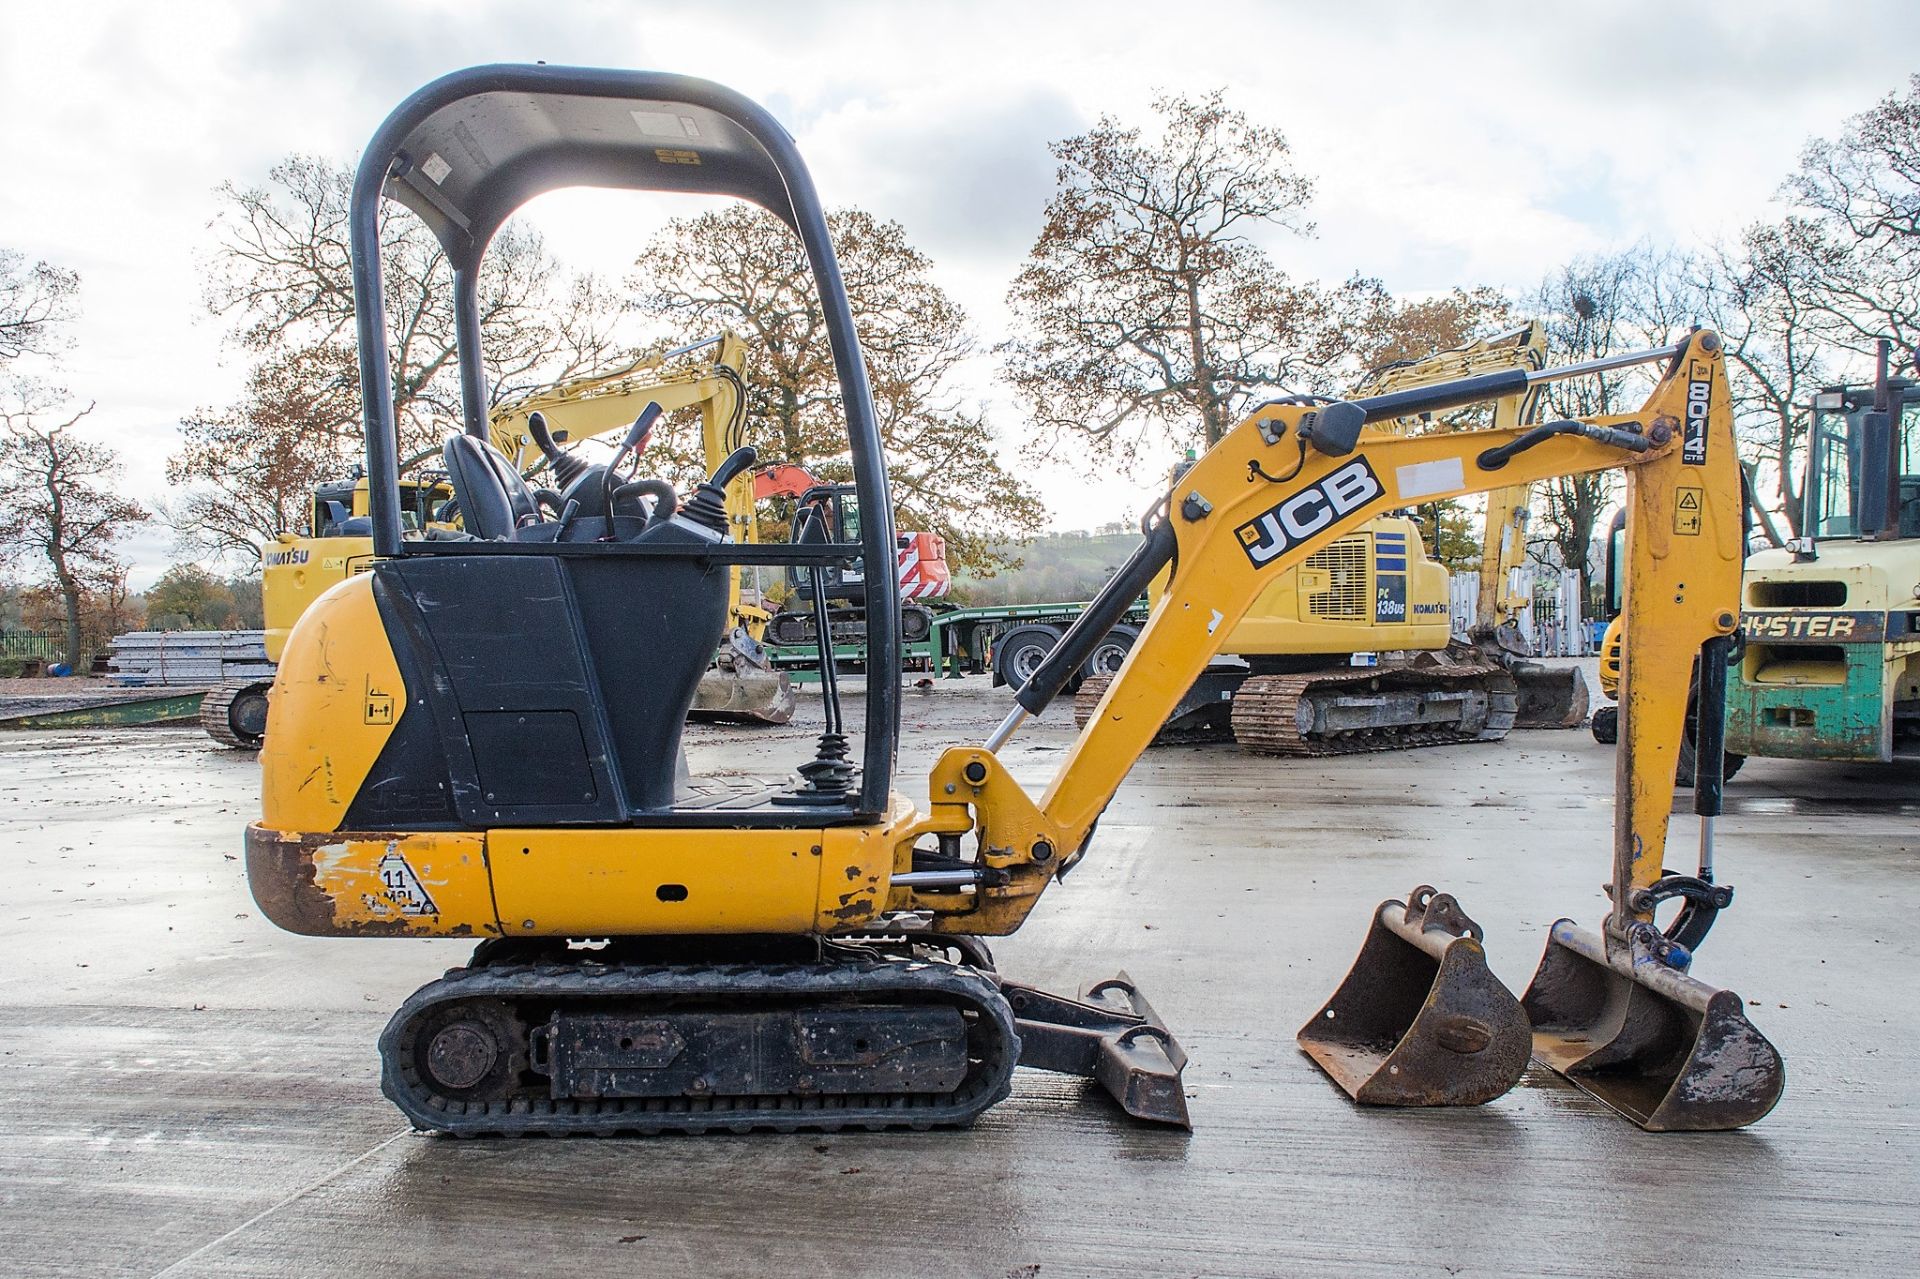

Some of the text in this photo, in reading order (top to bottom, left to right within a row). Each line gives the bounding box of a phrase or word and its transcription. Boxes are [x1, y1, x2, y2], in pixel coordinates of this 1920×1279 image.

[1684, 382, 1710, 455] 8014
[1249, 462, 1378, 562] JCB
[265, 547, 309, 566] OMATSU
[1378, 587, 1390, 599] PC
[1413, 601, 1447, 614] KOMATSU
[383, 870, 406, 889] 11
